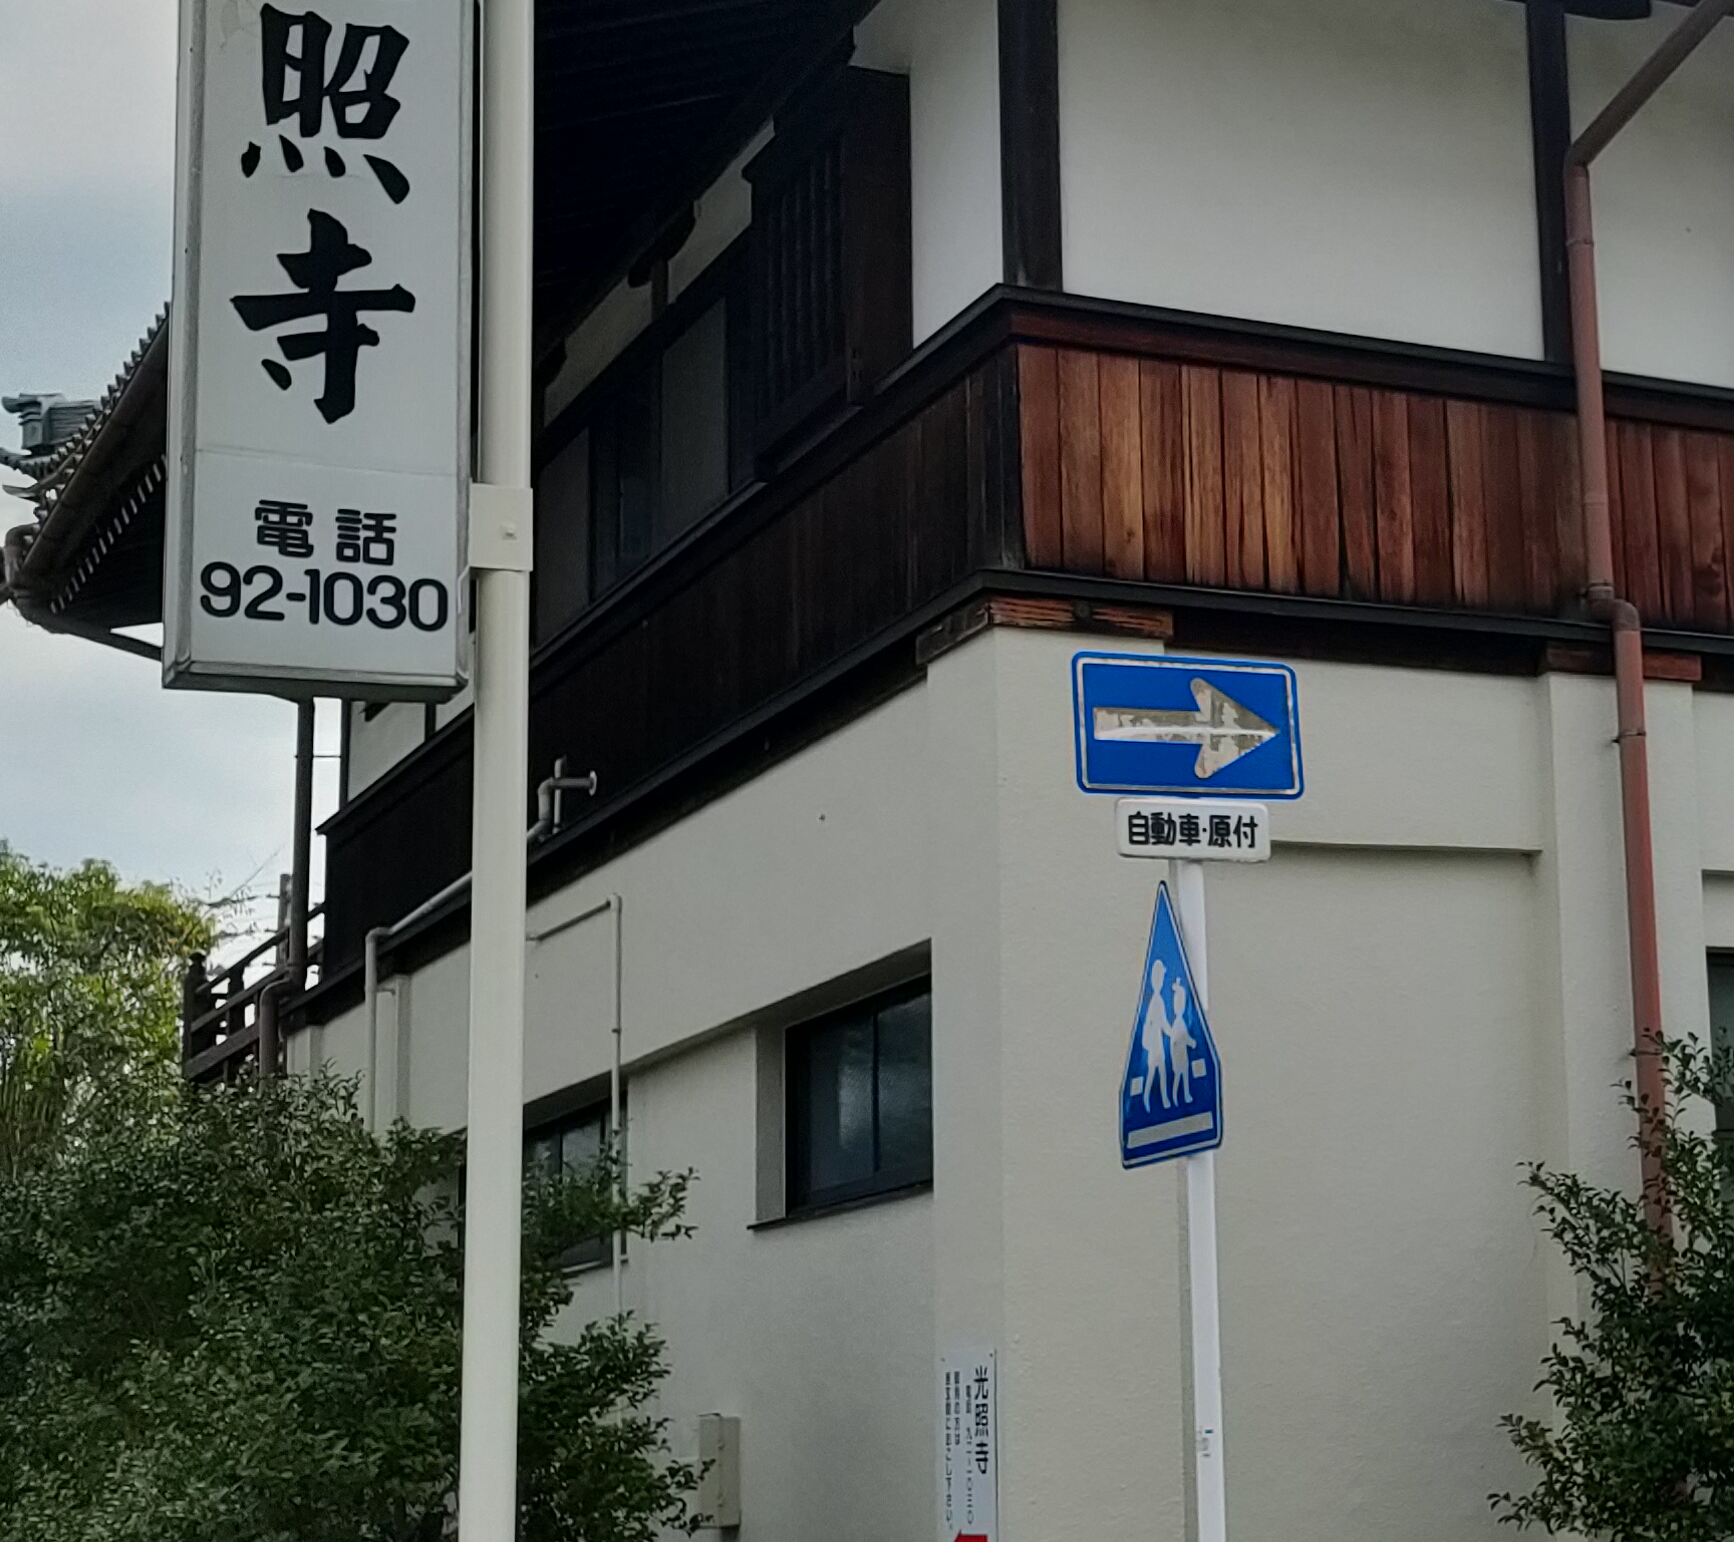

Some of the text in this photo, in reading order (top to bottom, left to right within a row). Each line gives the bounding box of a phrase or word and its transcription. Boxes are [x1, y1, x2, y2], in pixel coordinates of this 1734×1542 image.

[254, 500, 397, 567] 電話
[199, 561, 449, 632] 92-1030
[973, 1365, 989, 1475] 光照寺
